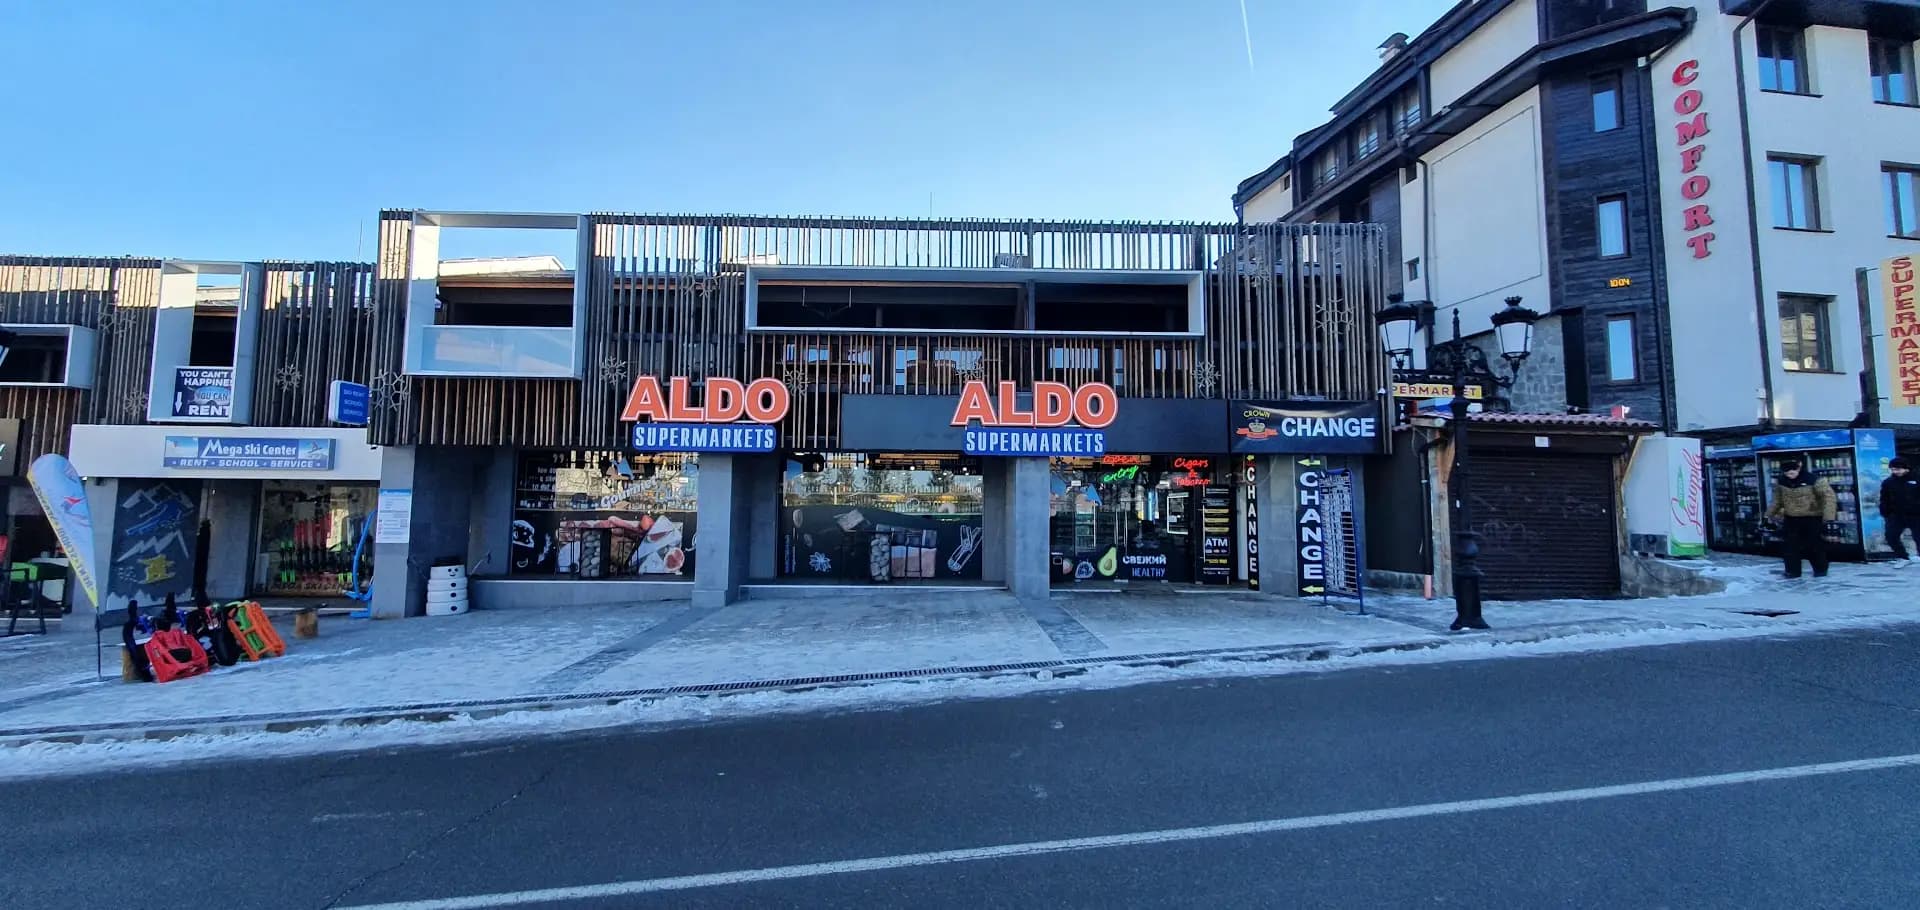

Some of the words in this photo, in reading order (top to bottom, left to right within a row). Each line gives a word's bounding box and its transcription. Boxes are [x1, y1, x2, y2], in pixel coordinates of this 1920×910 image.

[1672, 59, 1715, 259] COMFORT
[1890, 256, 1920, 405] SUPERMARKET
[620, 375, 790, 424] ALDO
[951, 380, 1118, 429] ALDO
[188, 405, 230, 416] RENT
[1243, 410, 1270, 418] CROWN
[635, 426, 774, 448] SUPERMARKETS
[1281, 417, 1376, 438] CHANGE
[201, 439, 242, 457] Mega
[244, 443, 260, 455] Ski
[263, 444, 296, 456] Center
[966, 431, 1104, 453] SUPERMARKETS
[180, 459, 208, 467] RENT
[218, 459, 259, 467] SCHOOL
[270, 460, 313, 468] SERVICE
[1174, 457, 1208, 470] Cigars
[1246, 466, 1258, 573] CHANGE
[1300, 471, 1324, 580] CHANGE
[1205, 538, 1228, 547] ATM
[1122, 554, 1167, 564] СВЕЖИЙ
[1132, 567, 1166, 577] HEALTHY
